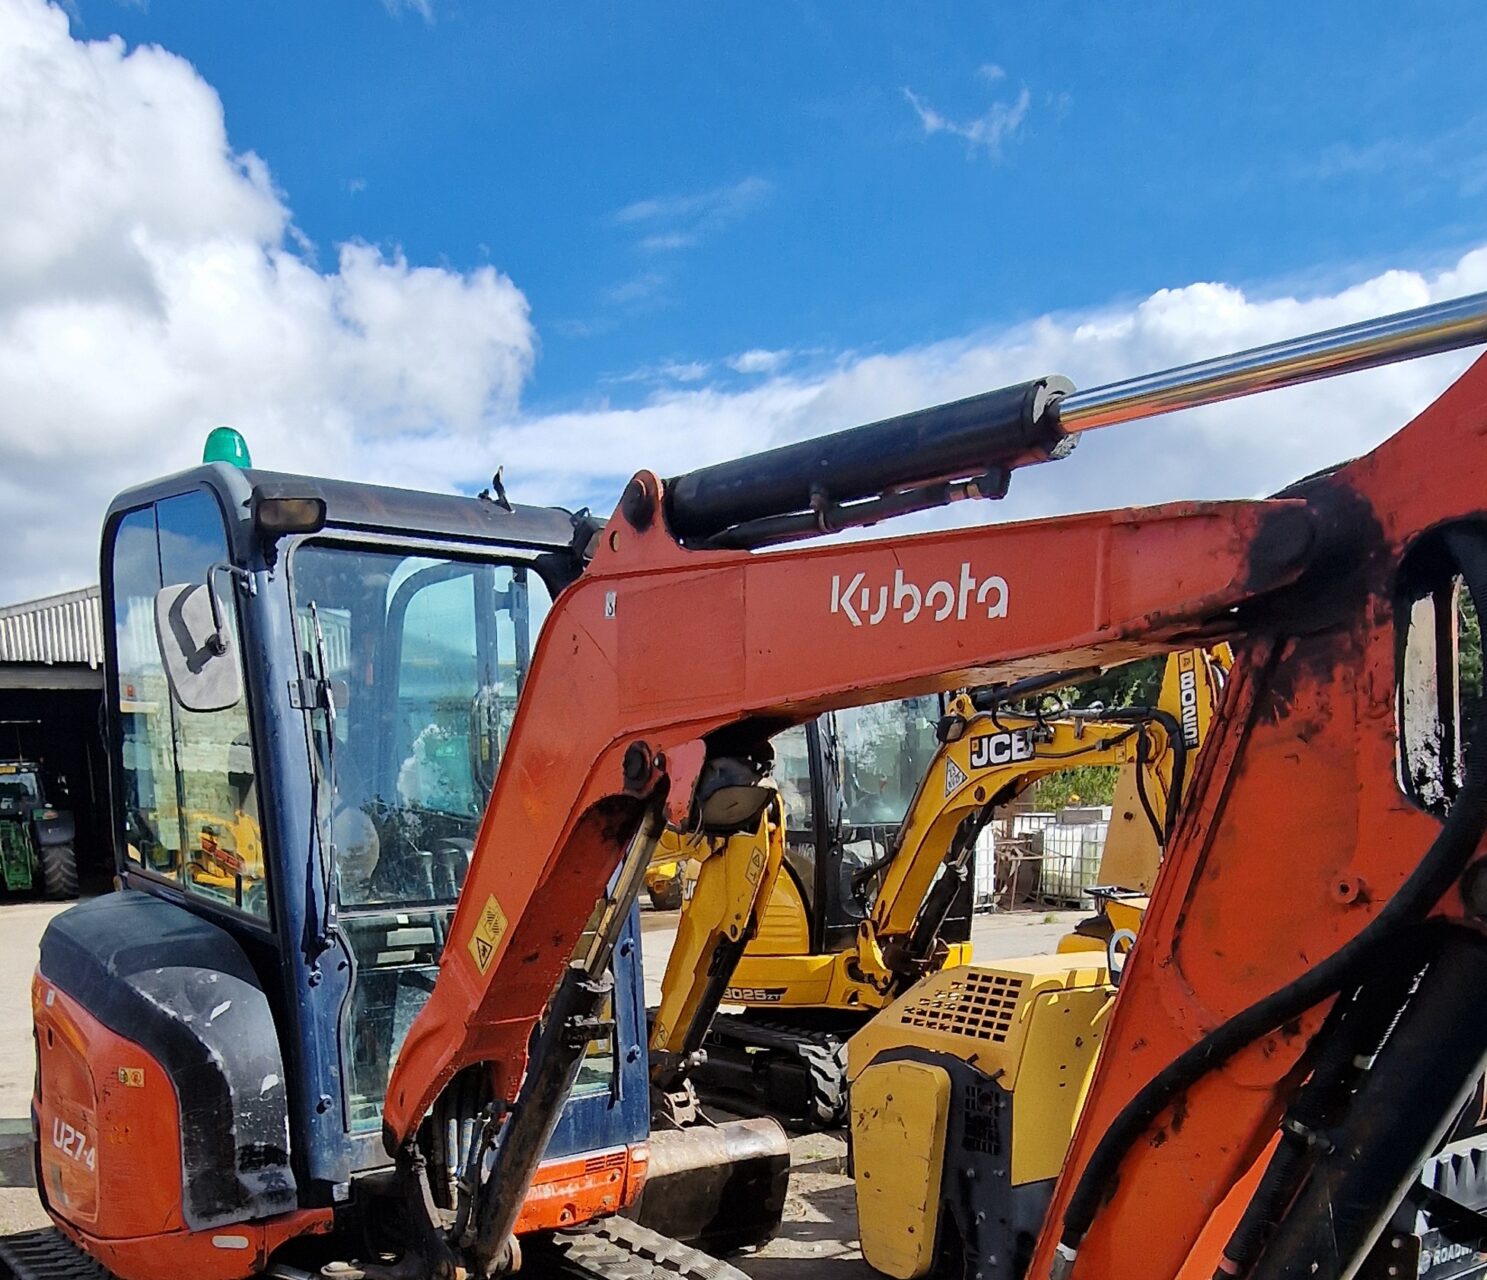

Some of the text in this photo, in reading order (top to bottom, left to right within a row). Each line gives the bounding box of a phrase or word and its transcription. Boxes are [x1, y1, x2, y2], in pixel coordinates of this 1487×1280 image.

[831, 562, 1009, 627] Kubota
[1181, 671, 1198, 739] 8025
[971, 731, 1031, 767] JCB
